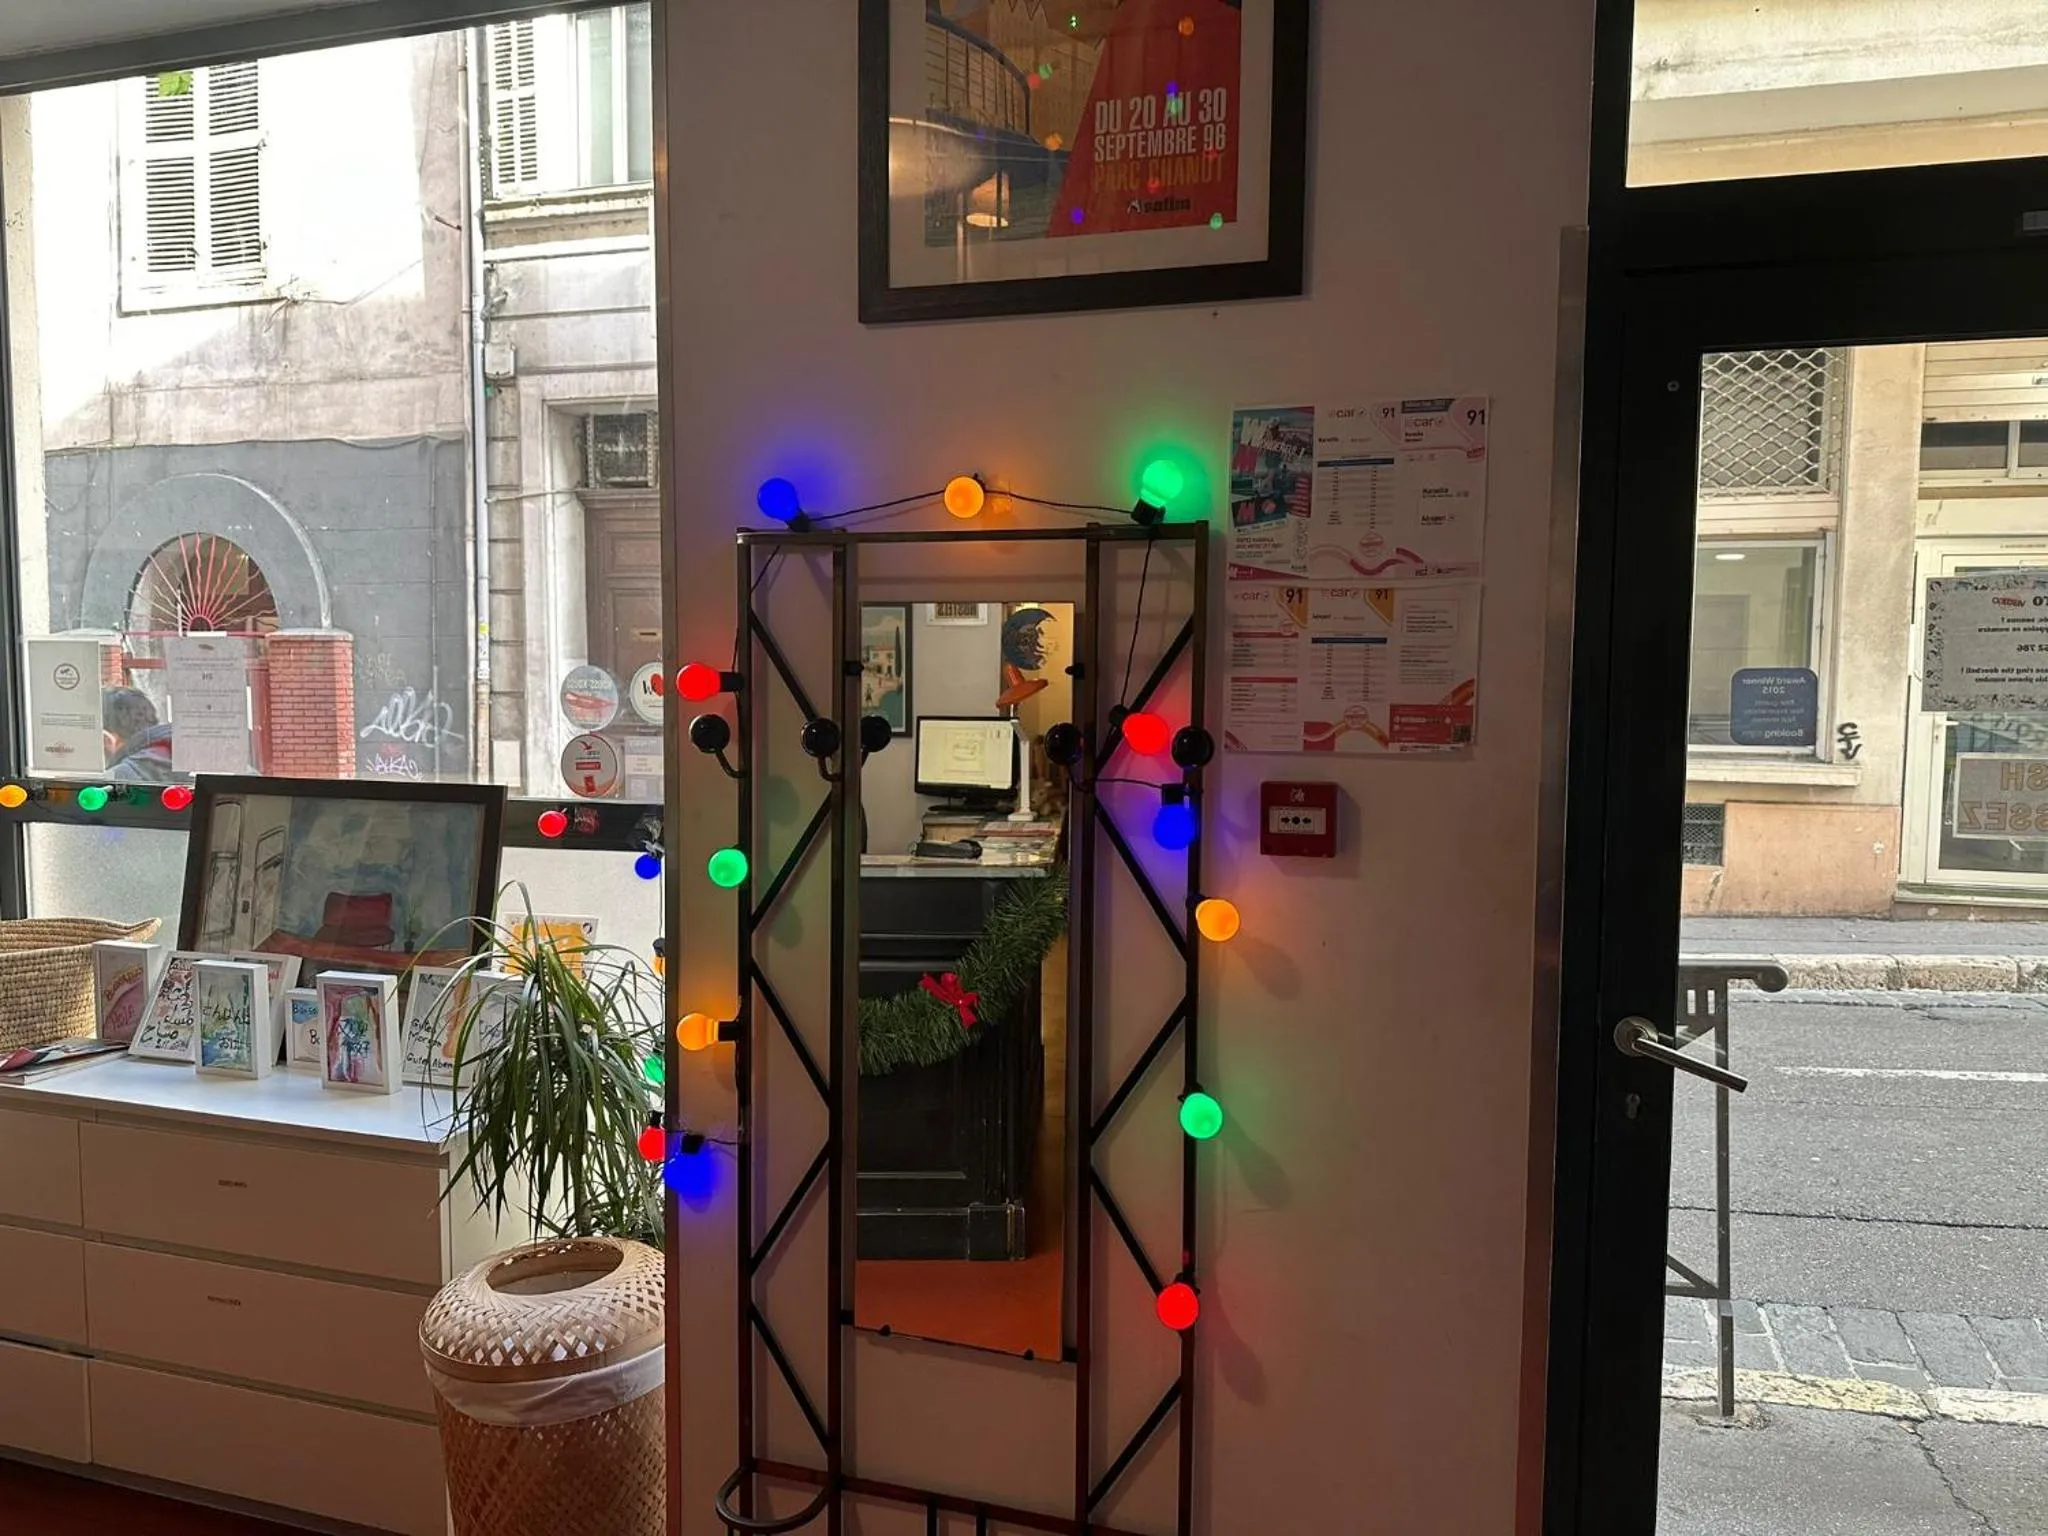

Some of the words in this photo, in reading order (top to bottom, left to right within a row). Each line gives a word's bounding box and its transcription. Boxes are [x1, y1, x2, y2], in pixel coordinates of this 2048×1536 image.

[1094, 99, 1122, 135] DU
[1128, 95, 1157, 131] 20
[1162, 91, 1192, 127] AU
[1198, 87, 1227, 123] 30
[1094, 125, 1197, 162] SEPTEMBRE
[1382, 407, 1396, 418] 91
[1466, 409, 1486, 426] 91
[1285, 588, 1304, 605] 91
[1375, 588, 1389, 600] 91
